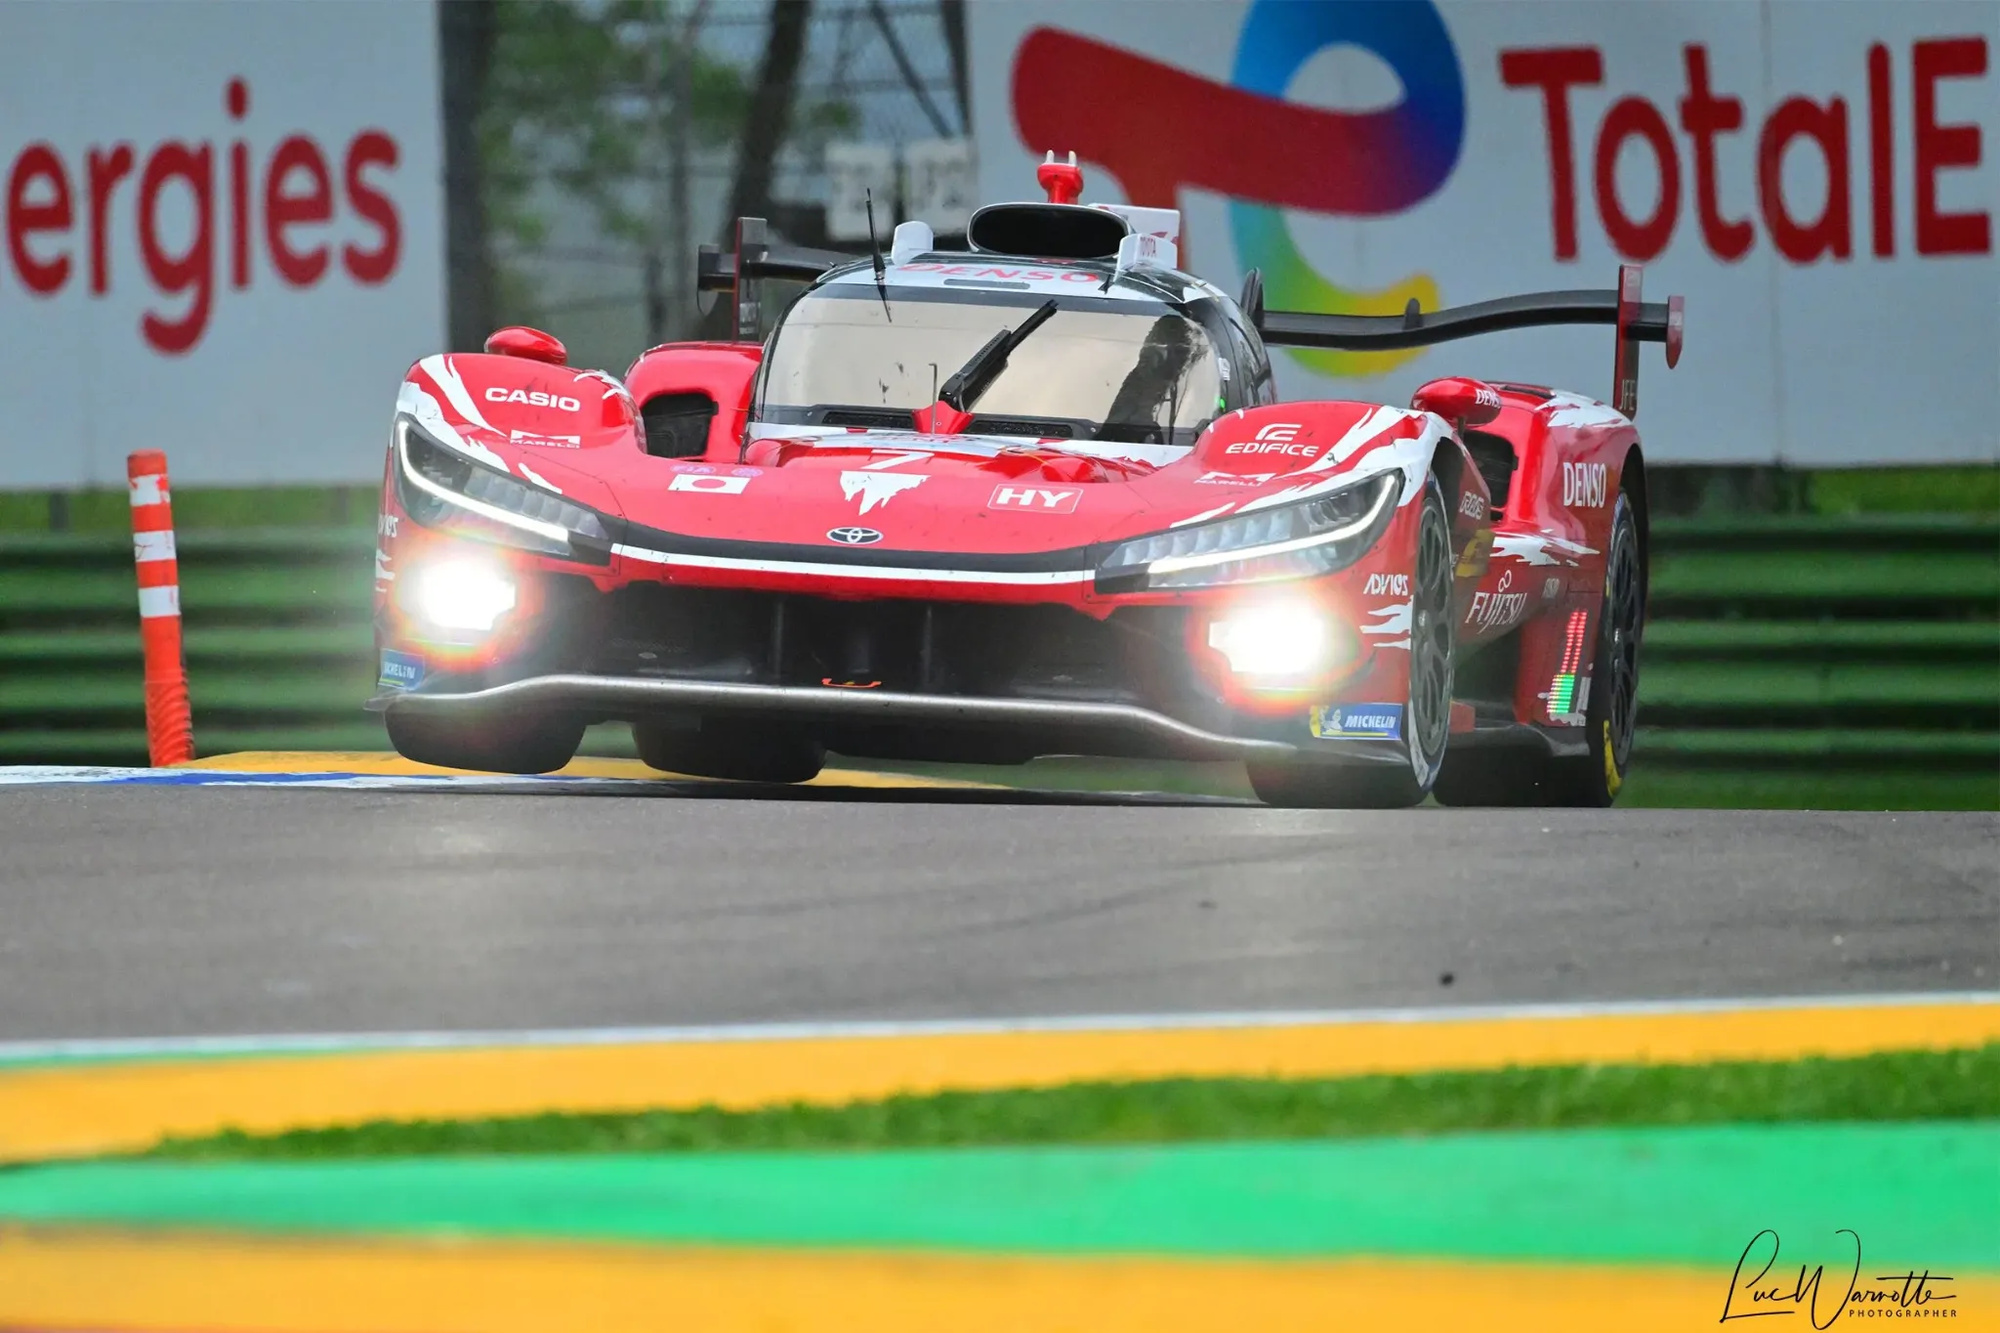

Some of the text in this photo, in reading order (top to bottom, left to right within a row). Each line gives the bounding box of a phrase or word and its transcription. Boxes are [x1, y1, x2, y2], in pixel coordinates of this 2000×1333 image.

[1499, 35, 1992, 265] TotalE
[5, 74, 404, 357] ergies
[897, 262, 1101, 283] DENSO
[484, 387, 581, 413] CASIO
[509, 439, 580, 449] MARELLI
[1225, 442, 1319, 457] EDIFICE
[1562, 461, 1607, 509] DENSO
[996, 487, 1075, 508] HY
[1464, 591, 1528, 635] FUJITSU
[1344, 715, 1397, 729] MICHELIN
